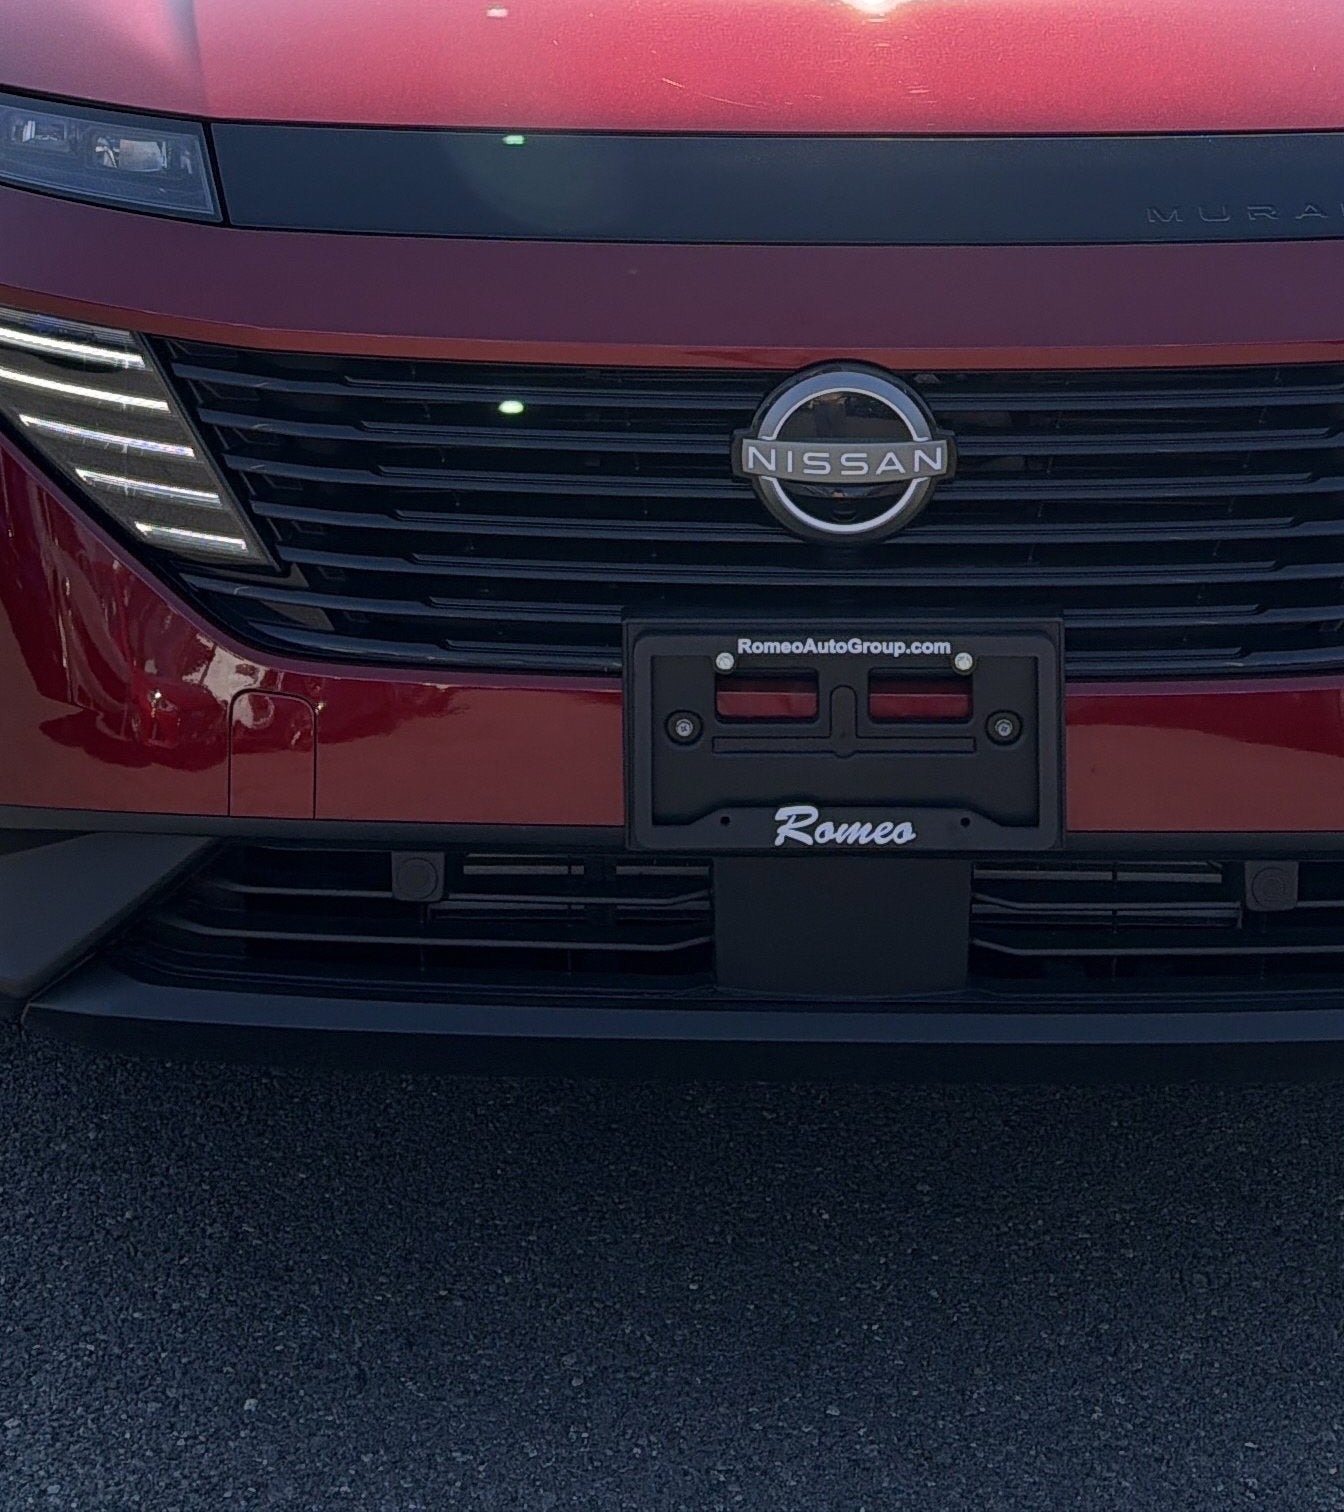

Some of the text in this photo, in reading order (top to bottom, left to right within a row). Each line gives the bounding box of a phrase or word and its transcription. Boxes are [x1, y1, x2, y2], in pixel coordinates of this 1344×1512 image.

[747, 445, 943, 476] NISSAN
[737, 638, 952, 658] RomeoAutoGroup.com
[774, 805, 917, 847] Romeo
